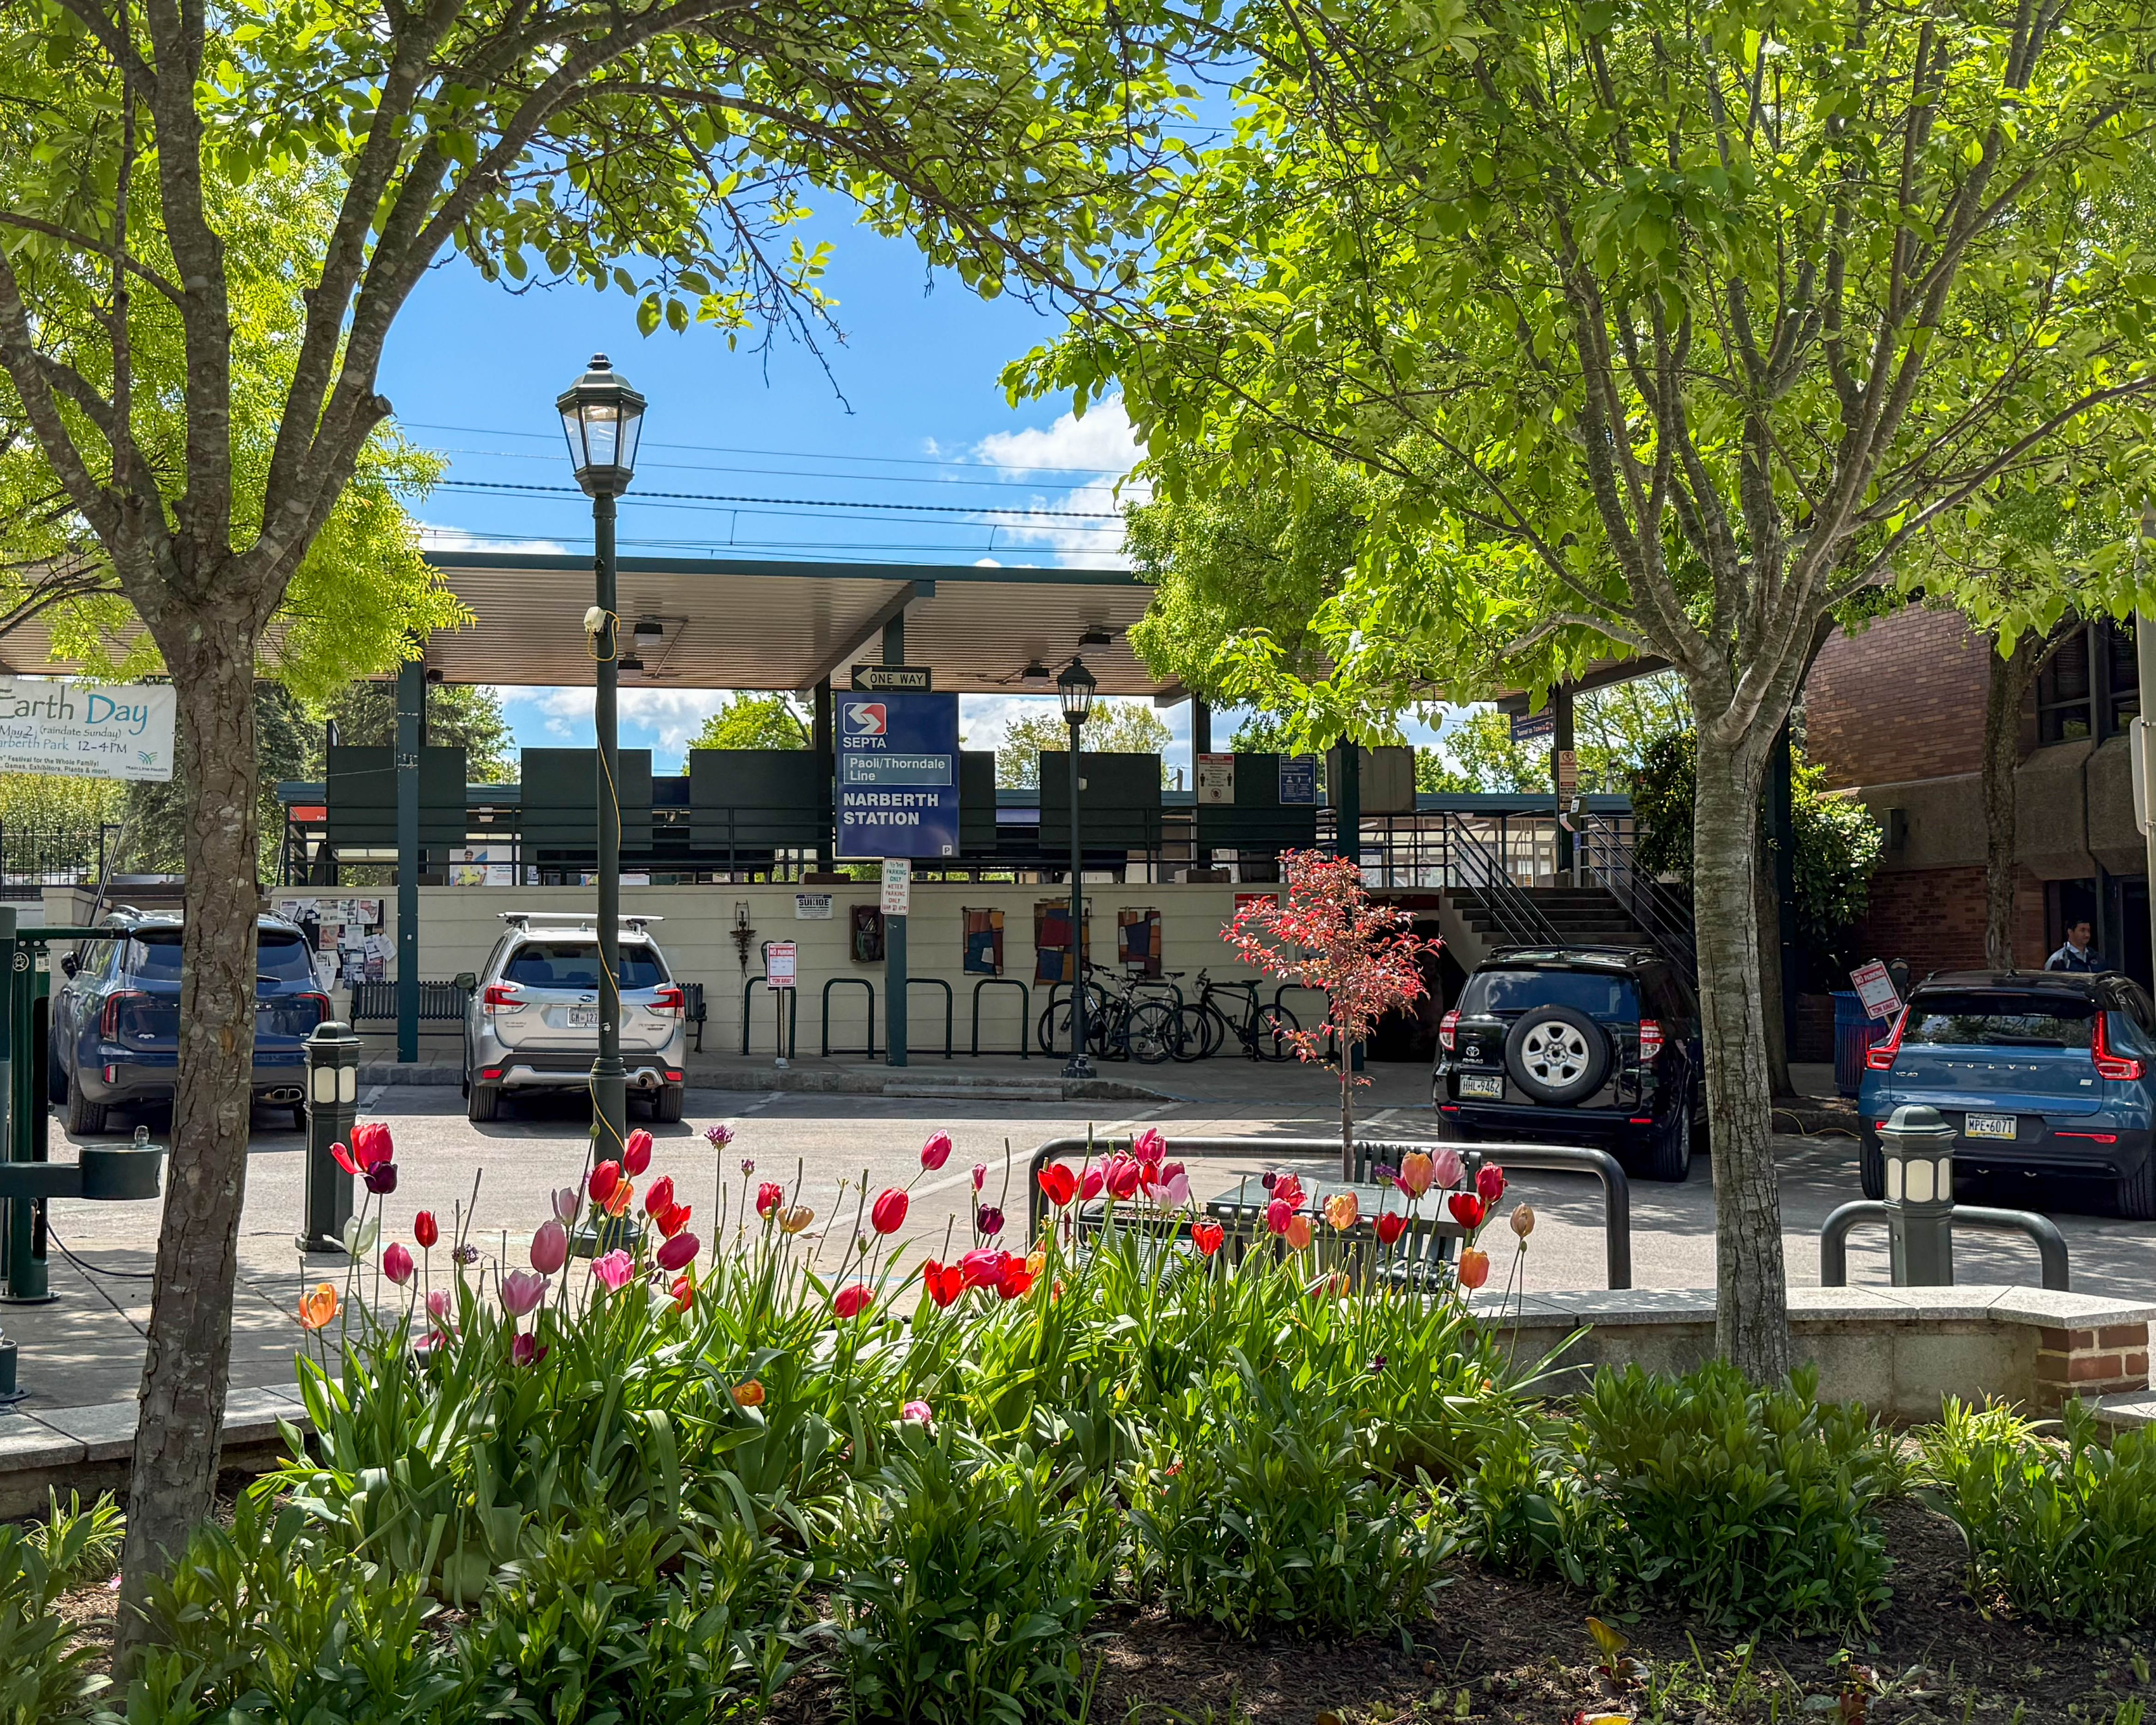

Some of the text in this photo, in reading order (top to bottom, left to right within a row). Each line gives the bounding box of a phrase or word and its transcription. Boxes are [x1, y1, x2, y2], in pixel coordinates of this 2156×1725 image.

[870, 674, 923, 684] ONE WAY
[0, 685, 148, 736] Earth Day
[0, 724, 23, 738] May
[40, 724, 81, 737] (raindate
[84, 726, 121, 741] Sunday)
[43, 736, 69, 750] Park
[843, 737, 887, 748] SEPTA
[850, 758, 946, 769] Paoli/Thorndale
[850, 770, 876, 781] Line
[843, 793, 939, 807] NARBERTH
[843, 811, 920, 825] STATION
[1947, 1062, 2037, 1071] VOLVO
